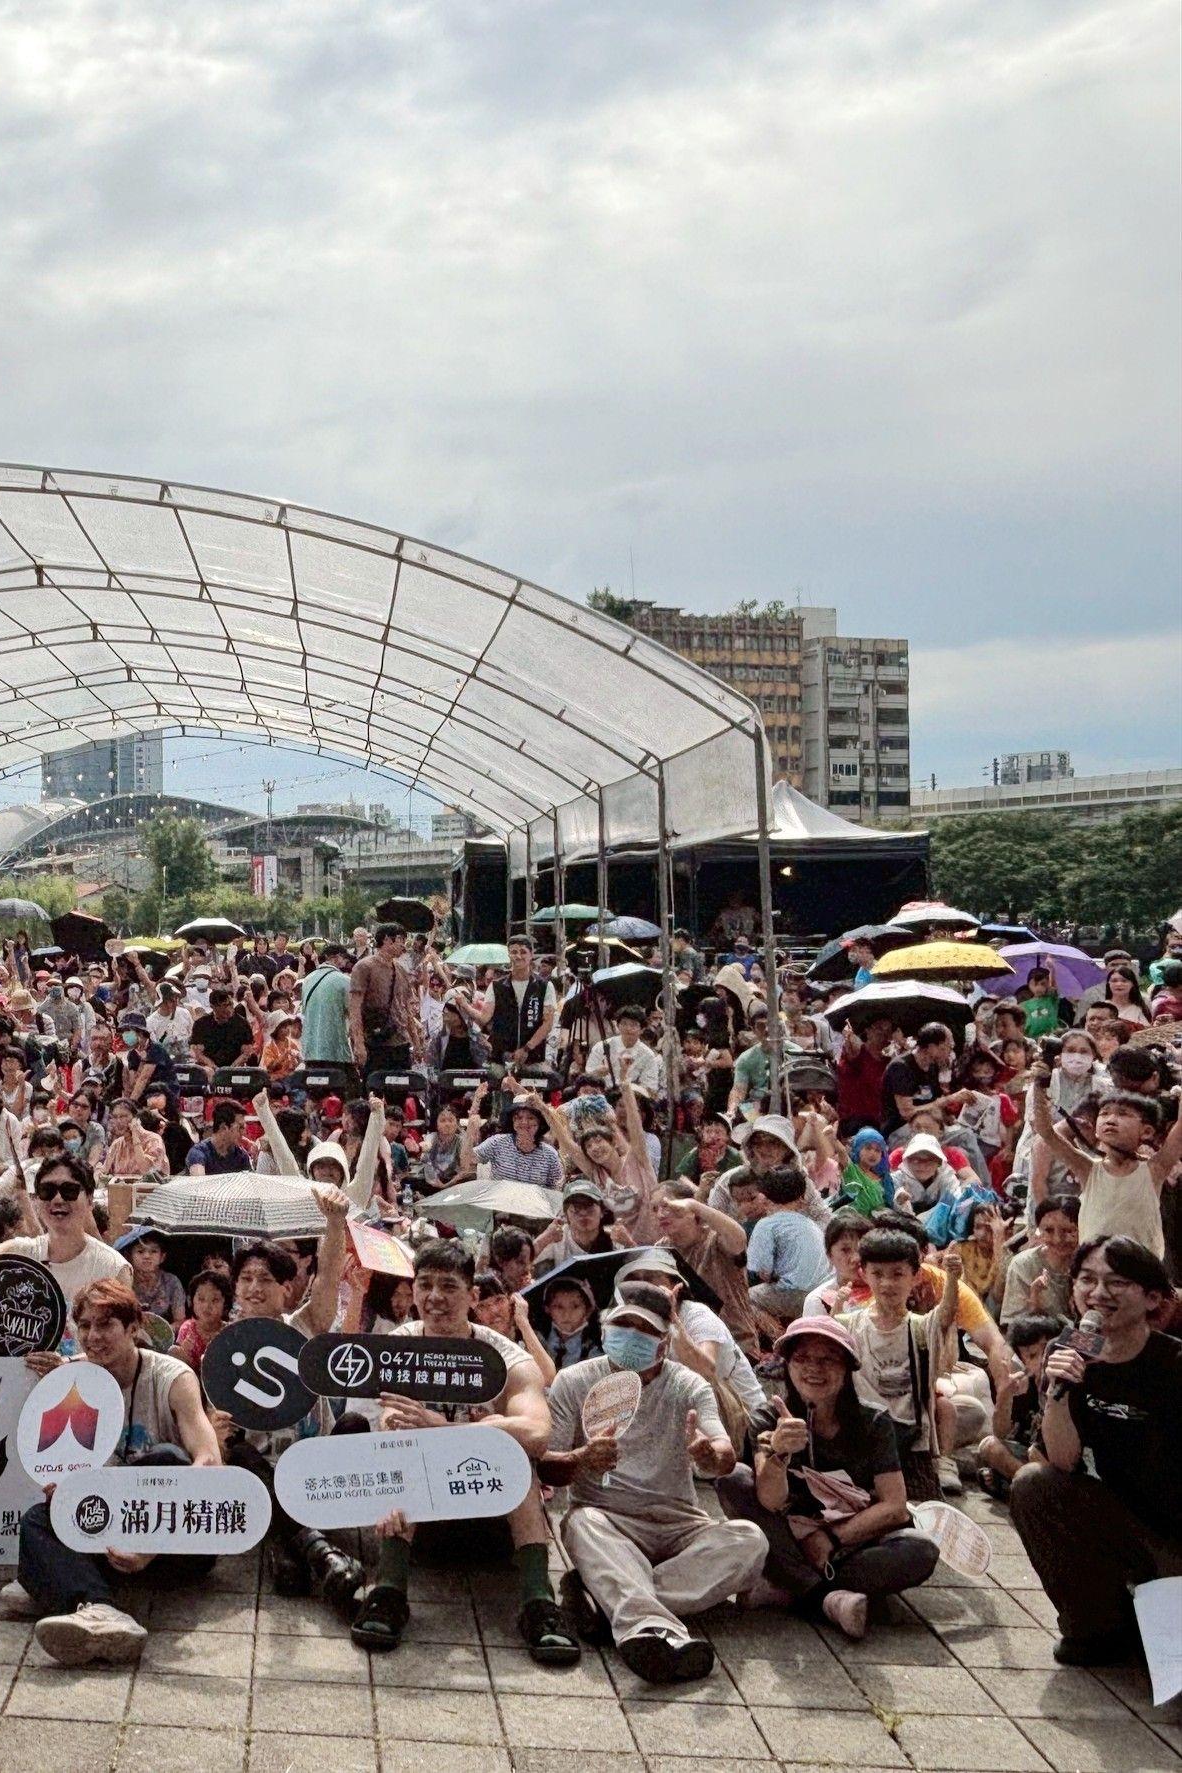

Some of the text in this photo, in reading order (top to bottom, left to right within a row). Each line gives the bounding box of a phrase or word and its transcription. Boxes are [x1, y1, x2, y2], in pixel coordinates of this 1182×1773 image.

[7, 1315, 41, 1340] WALK
[380, 1351, 420, 1366] 0471
[448, 1477, 504, 1496] 田中央
[120, 1499, 248, 1535] 滿月精釀
